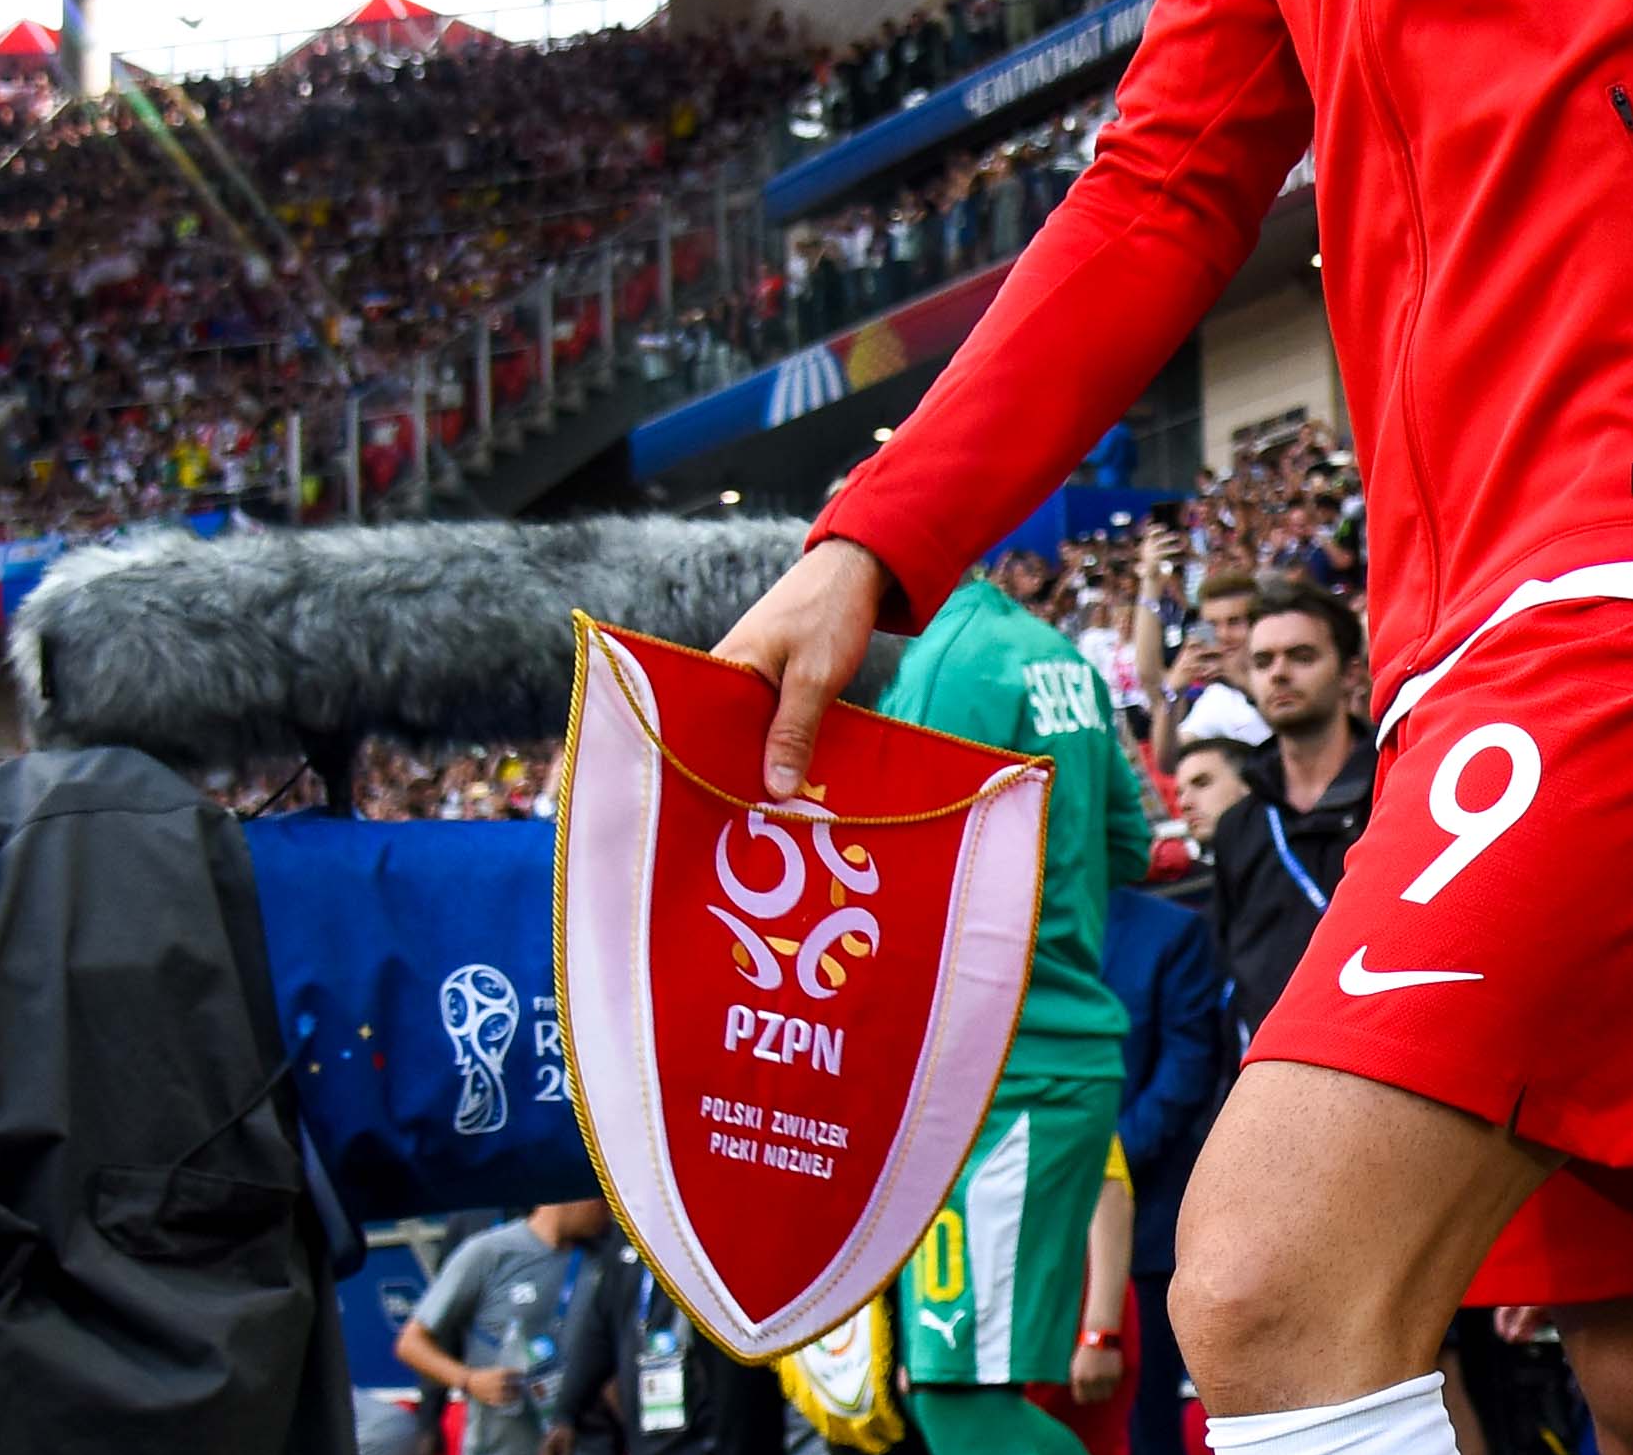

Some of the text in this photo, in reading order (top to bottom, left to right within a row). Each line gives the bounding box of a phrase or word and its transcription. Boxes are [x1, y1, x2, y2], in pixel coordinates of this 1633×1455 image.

[1399, 722, 1543, 905] 9
[724, 1004, 844, 1077] PZPN
[700, 1095, 849, 1149] POLSKI ZWIĄZEK
[710, 1132, 835, 1180] PIŁKI NOŻNEJ
